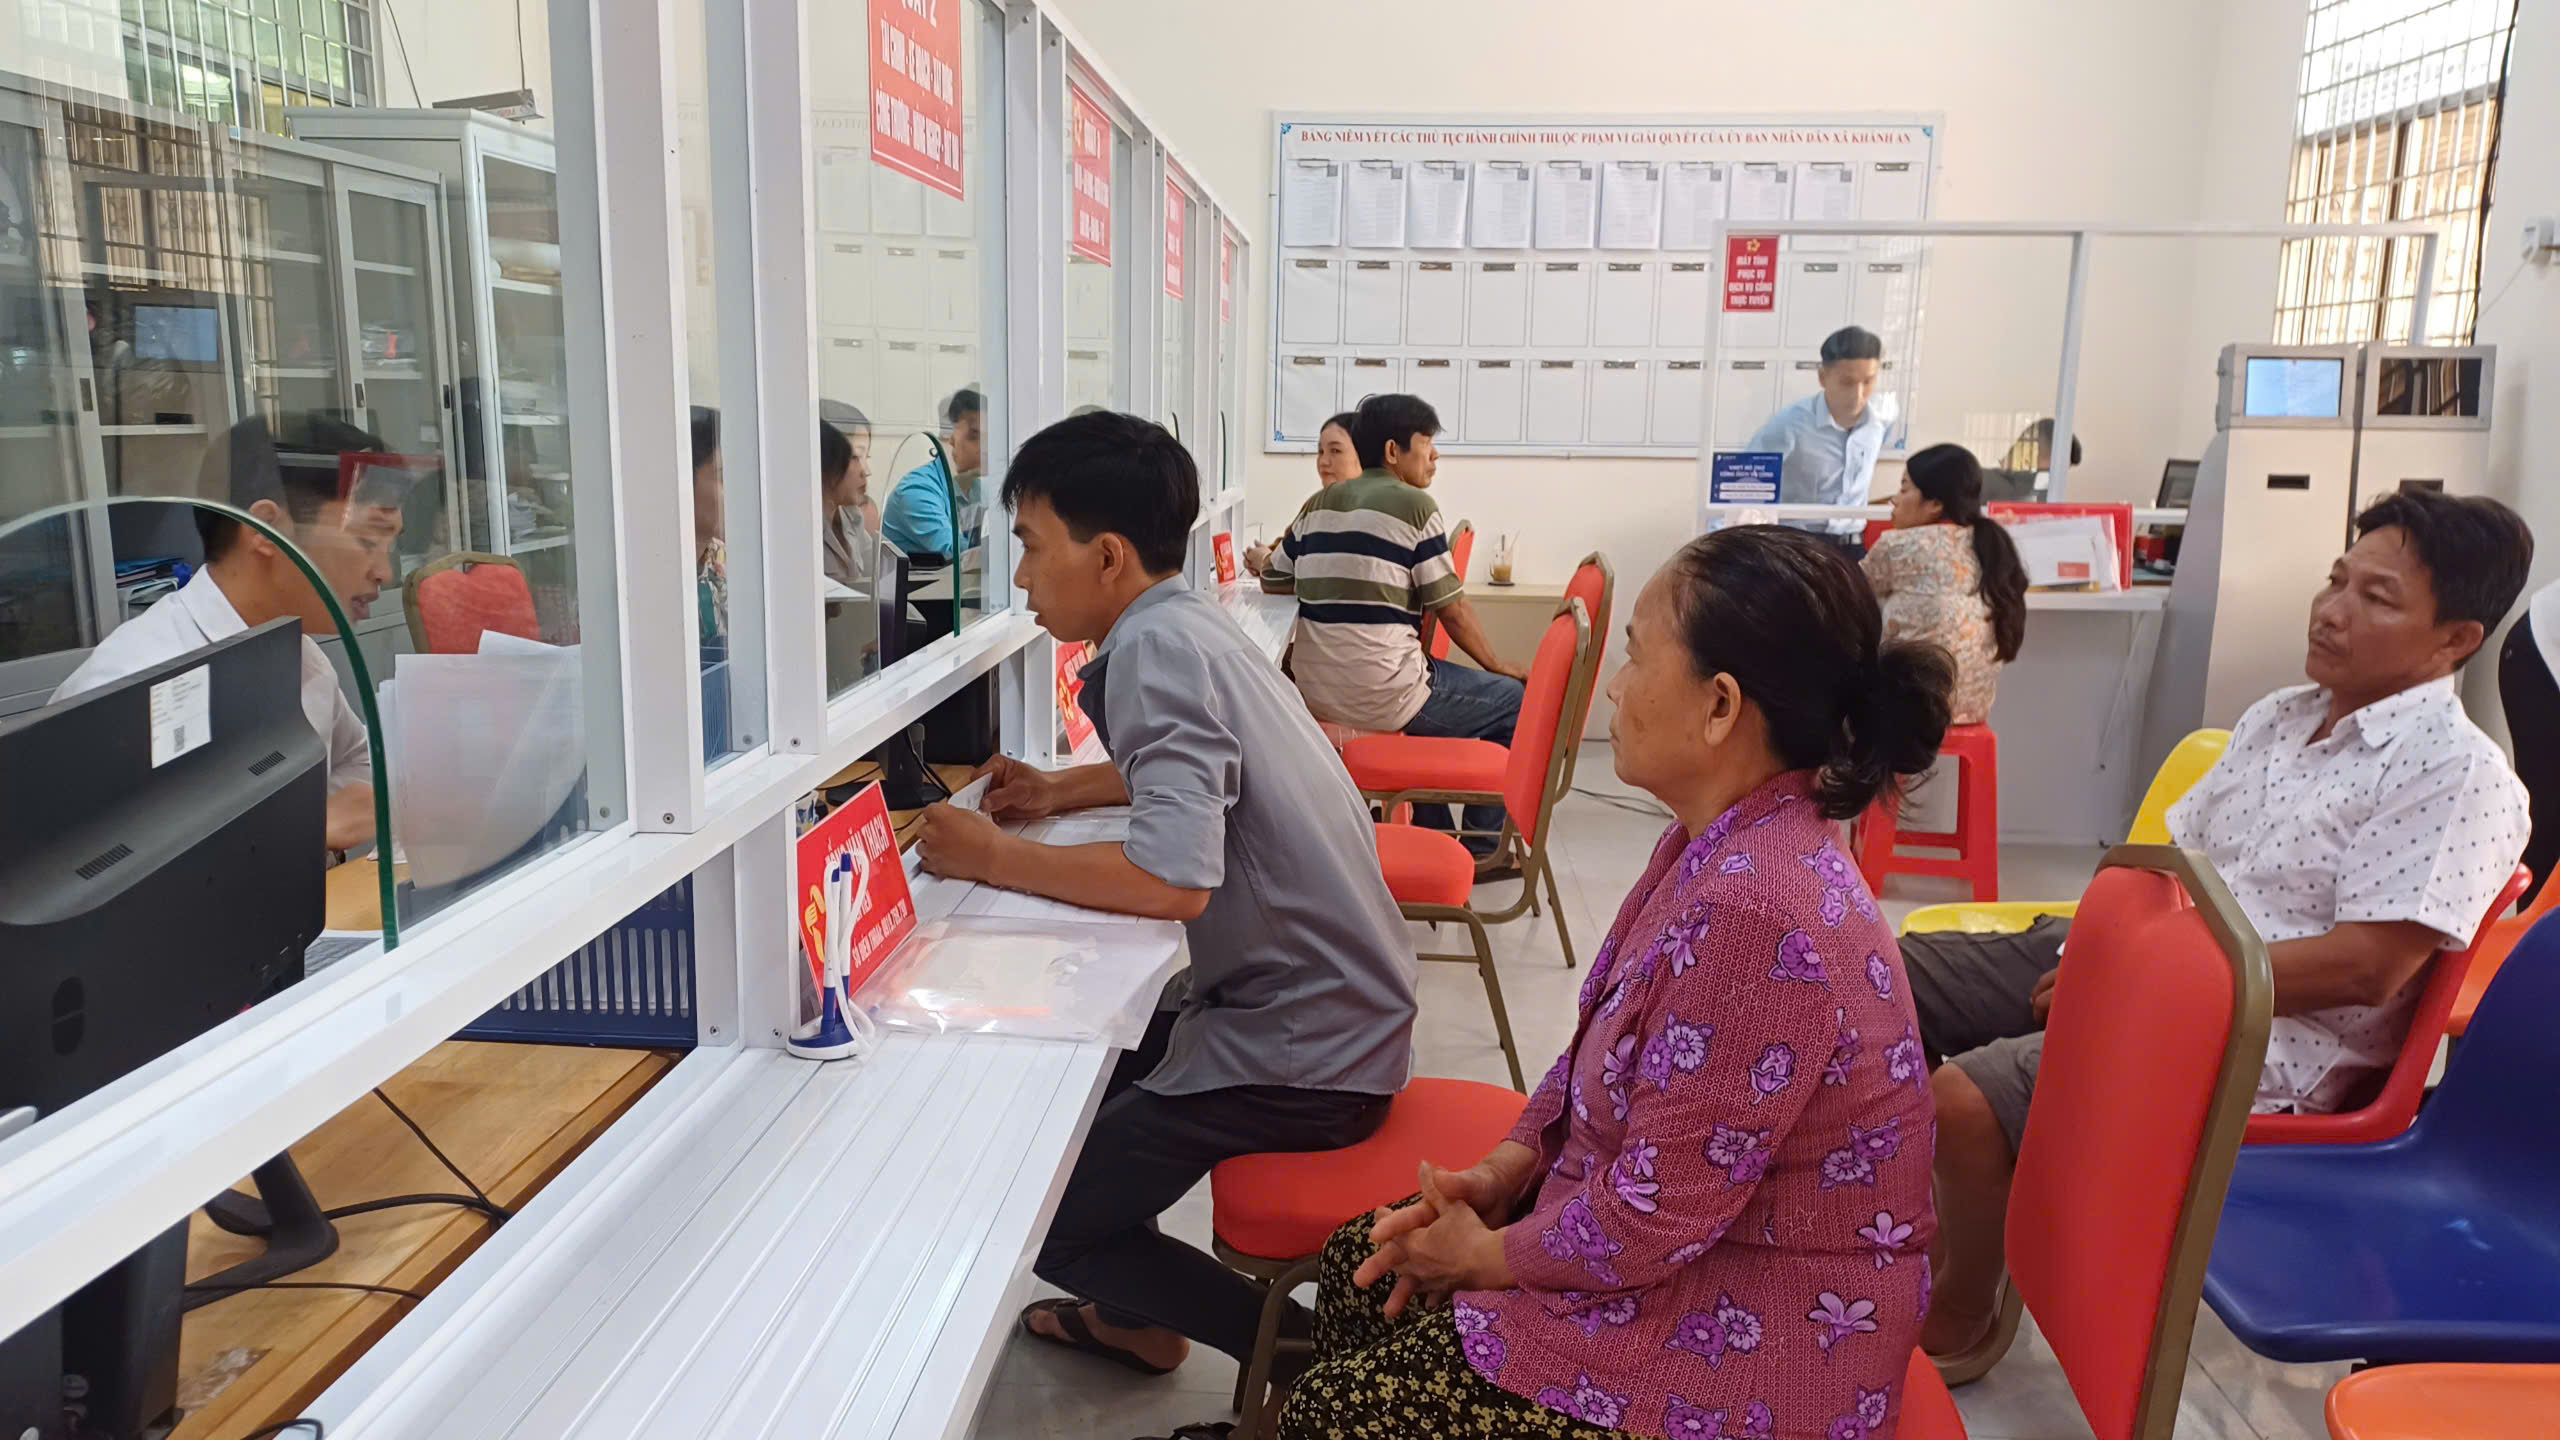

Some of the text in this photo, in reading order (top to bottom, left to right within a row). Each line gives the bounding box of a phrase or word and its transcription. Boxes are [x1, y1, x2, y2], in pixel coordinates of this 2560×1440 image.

[1301, 127, 1332, 143] BẢNG
[1334, 129, 1363, 143] NIÊM
[1390, 128, 1414, 143] CÁC
[1416, 128, 1439, 143] THỦ
[1441, 132, 1464, 146] TỤC
[1465, 129, 1496, 144] HÀNH
[1499, 129, 1536, 144] CHÍNH
[1539, 130, 1579, 146] THUỘC
[1581, 132, 1615, 147] PHẠM
[1616, 132, 1630, 144] VI
[1631, 129, 1656, 144] GIẢI
[1658, 128, 1698, 145] QUYẾT
[1700, 129, 1724, 144] CỦA
[1745, 132, 1769, 144] BAN
[1771, 129, 1803, 144] NHÂN
[1806, 129, 1830, 144] DÂN
[1832, 129, 1849, 144] XÃ
[1851, 129, 1894, 144] KHÁNH
[1896, 132, 1911, 144] AN
[861, 812, 890, 864] THẠCH
